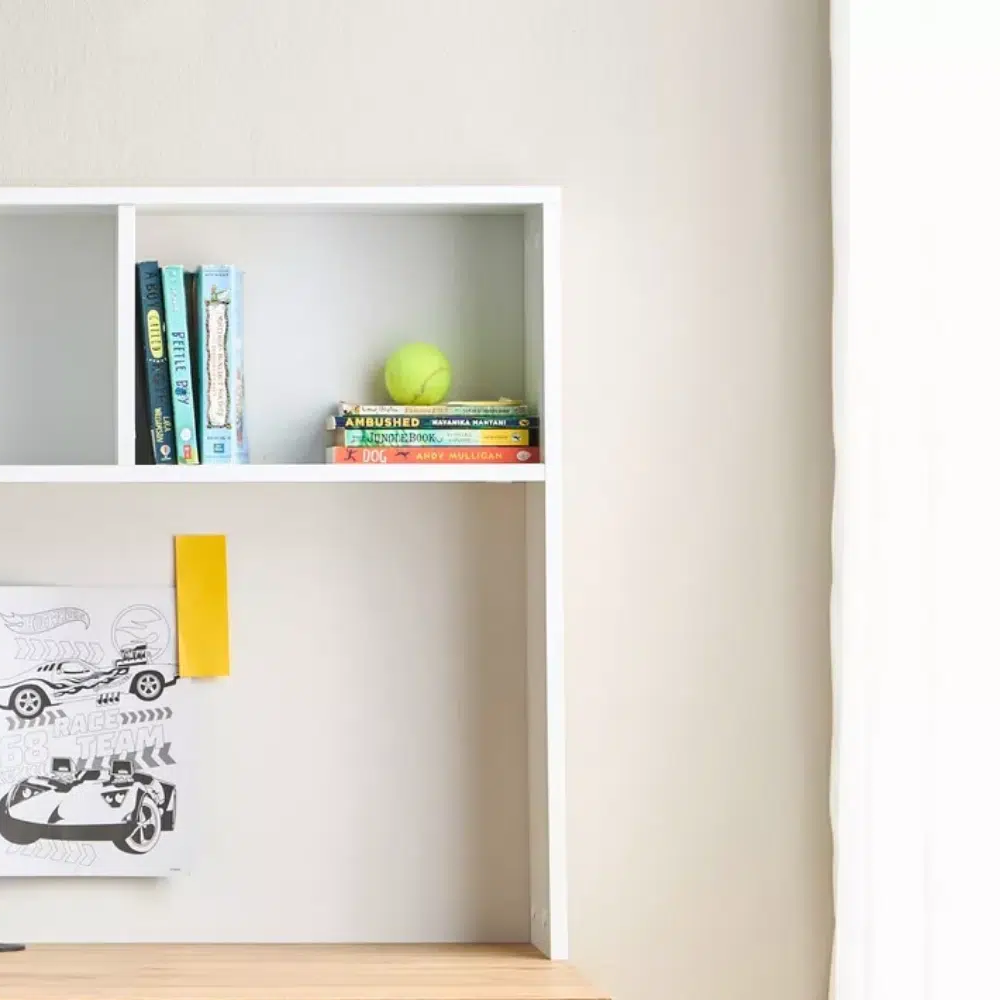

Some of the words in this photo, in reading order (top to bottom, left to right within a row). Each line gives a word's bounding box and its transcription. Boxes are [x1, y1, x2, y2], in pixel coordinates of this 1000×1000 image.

[171, 331, 187, 372] BEETLE
[345, 417, 420, 427] AMBUSHED
[362, 449, 388, 463] DOG
[416, 452, 444, 460] ANDY
[450, 452, 503, 460] MULLIGAN
[52, 708, 122, 738] RACE
[76, 724, 166, 759] TEAM
